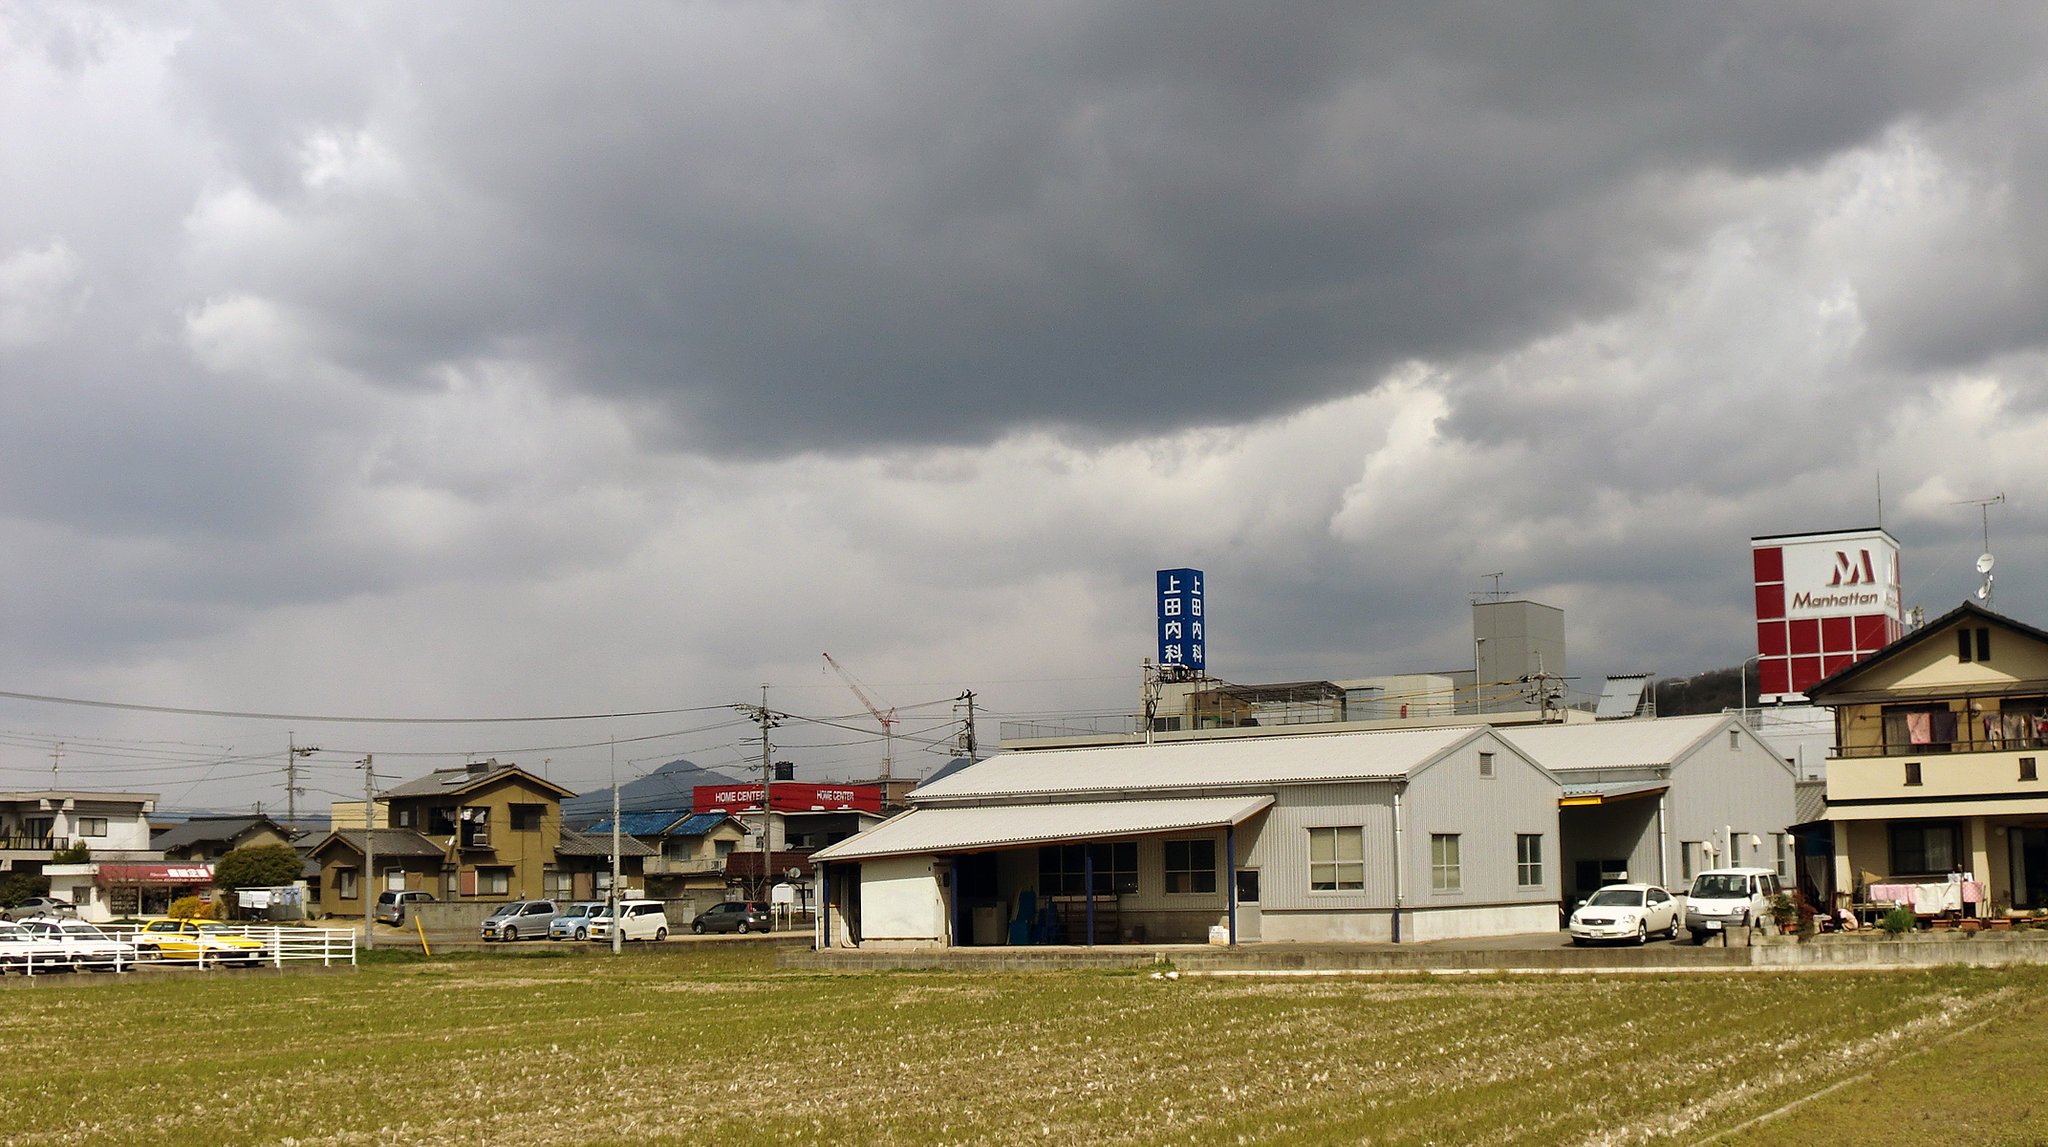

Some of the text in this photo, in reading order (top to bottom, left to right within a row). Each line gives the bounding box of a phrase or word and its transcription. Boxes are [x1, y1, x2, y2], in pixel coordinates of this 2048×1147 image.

[1792, 591, 1879, 610] Manhattan
[1163, 575, 1182, 663] 上田内科
[1191, 575, 1202, 663] 上田内科
[715, 790, 765, 803] HOME CENTER
[816, 790, 855, 801] HOME CENTER
